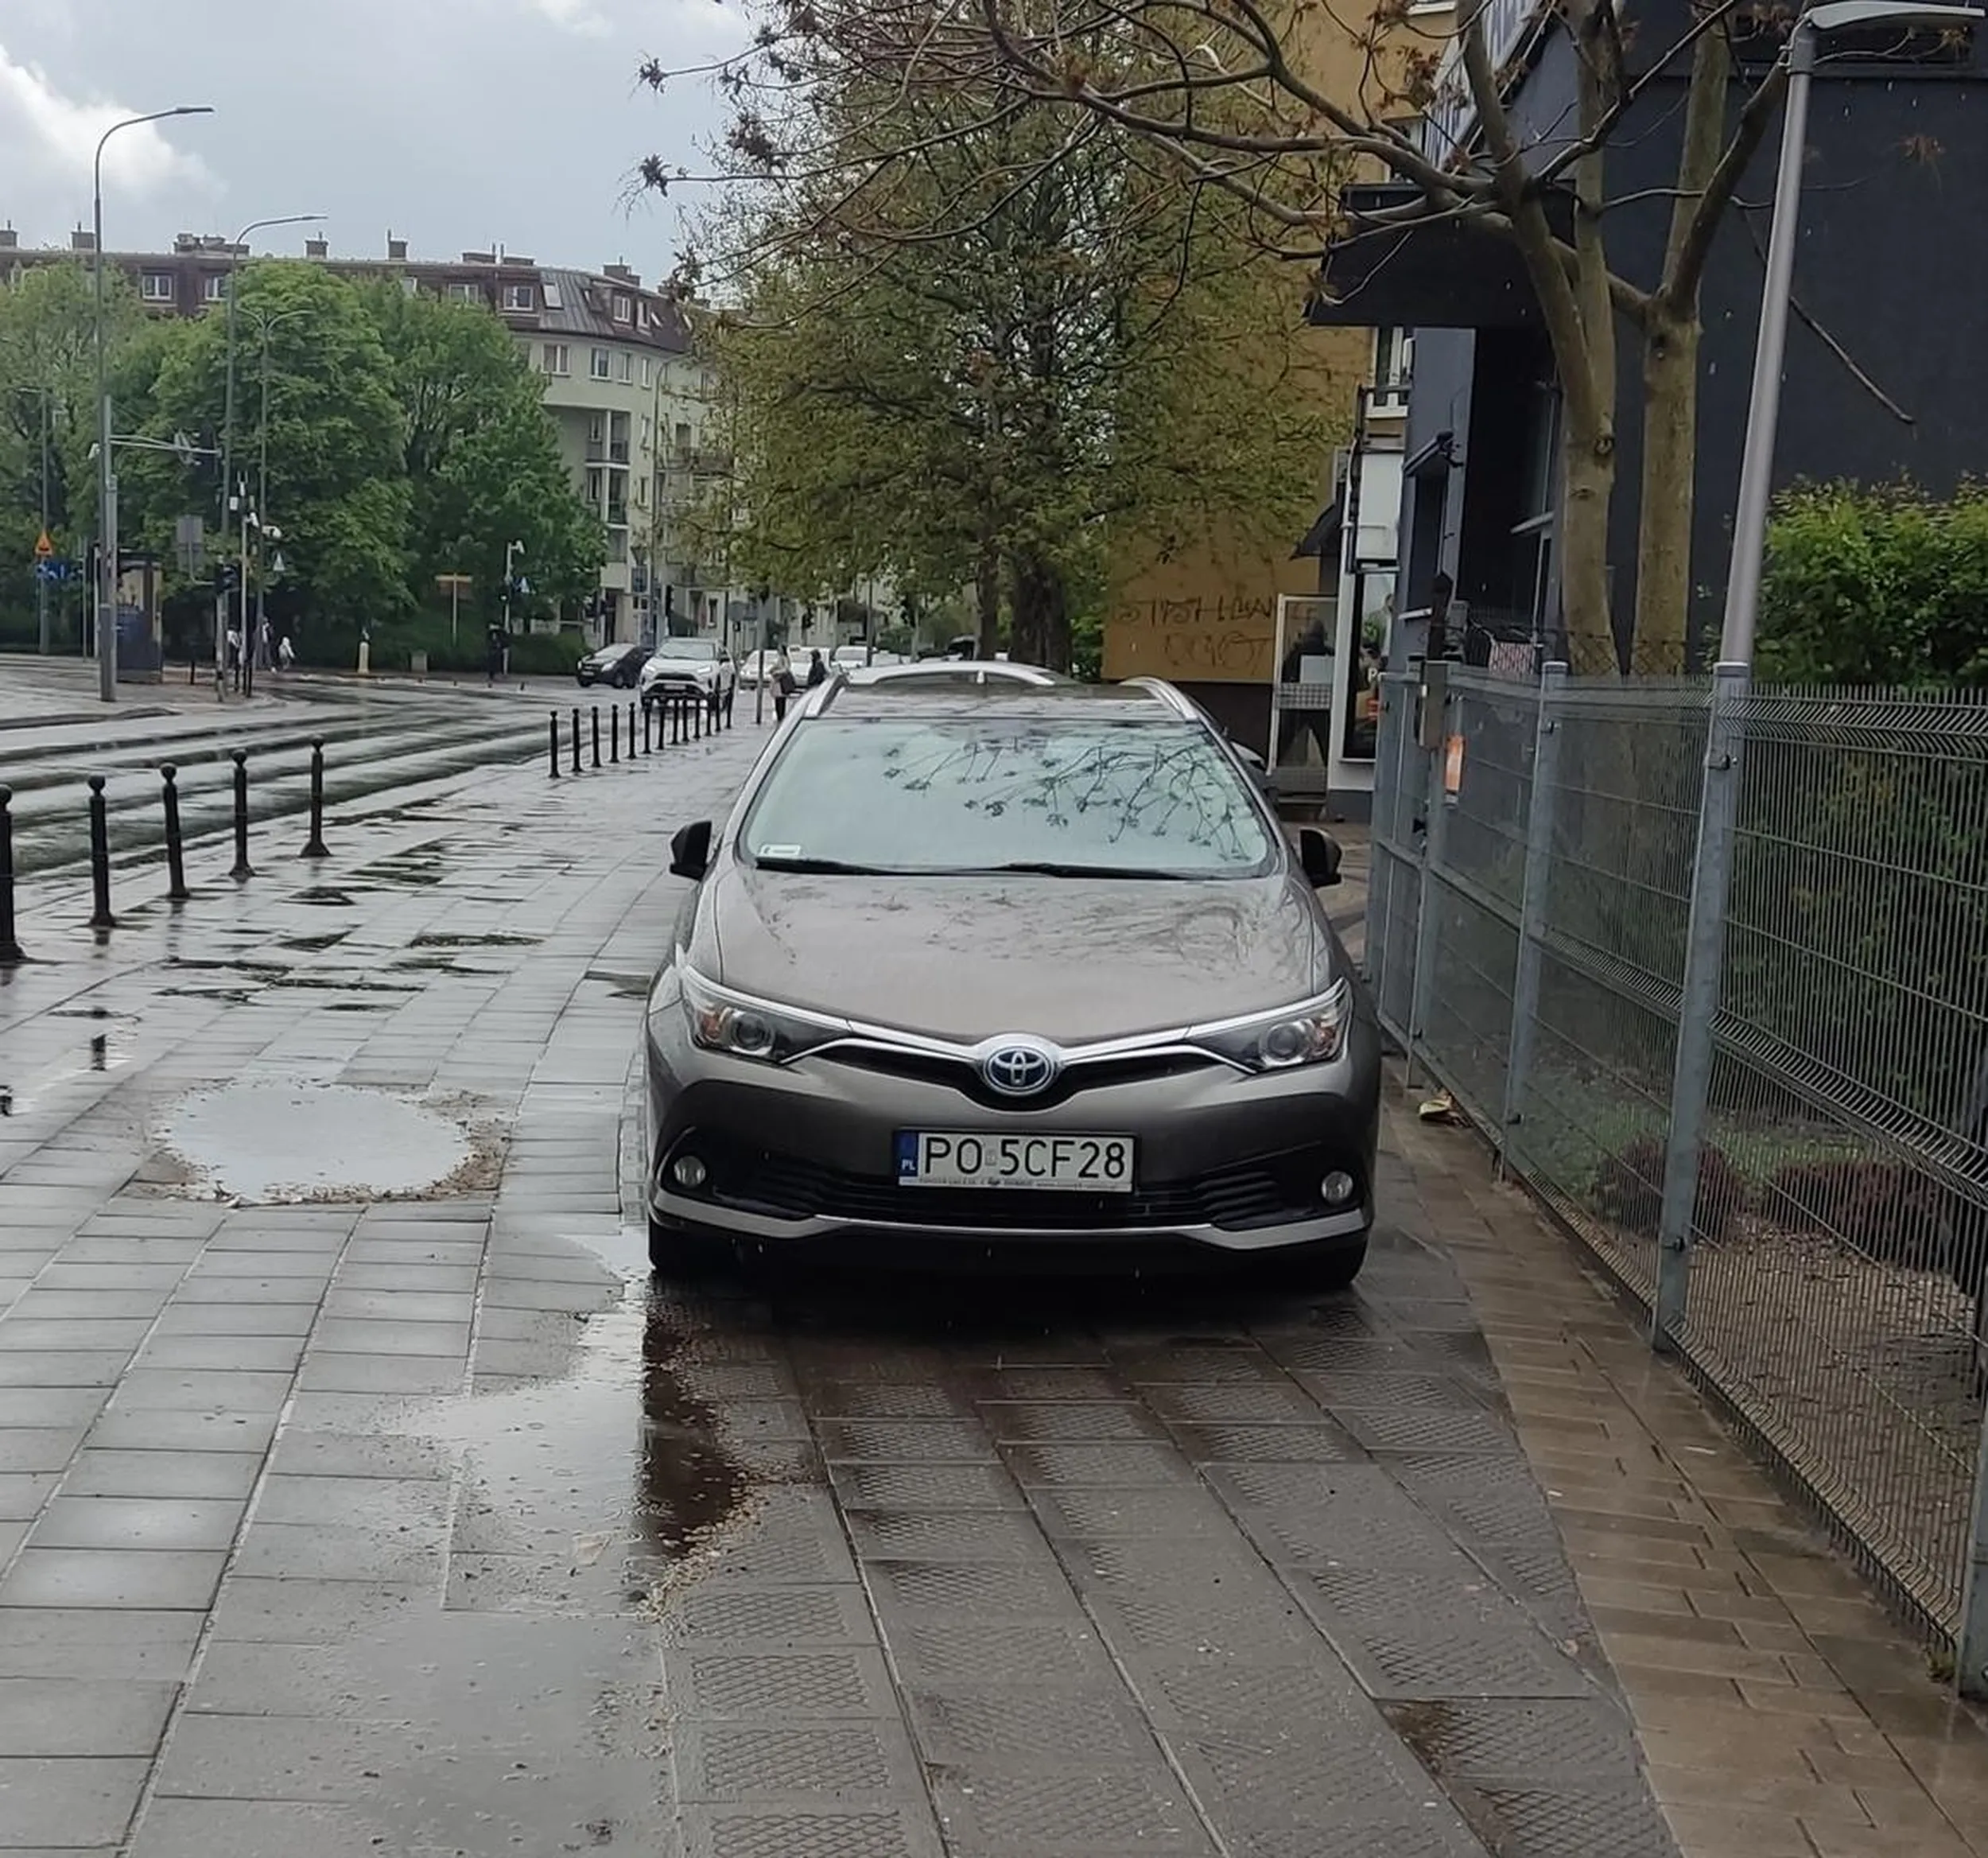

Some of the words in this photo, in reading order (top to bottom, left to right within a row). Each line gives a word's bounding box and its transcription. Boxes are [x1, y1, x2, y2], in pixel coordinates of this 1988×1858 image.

[901, 1159, 915, 1171] PL
[925, 1137, 983, 1175] PO
[999, 1139, 1125, 1179] 5CF28
